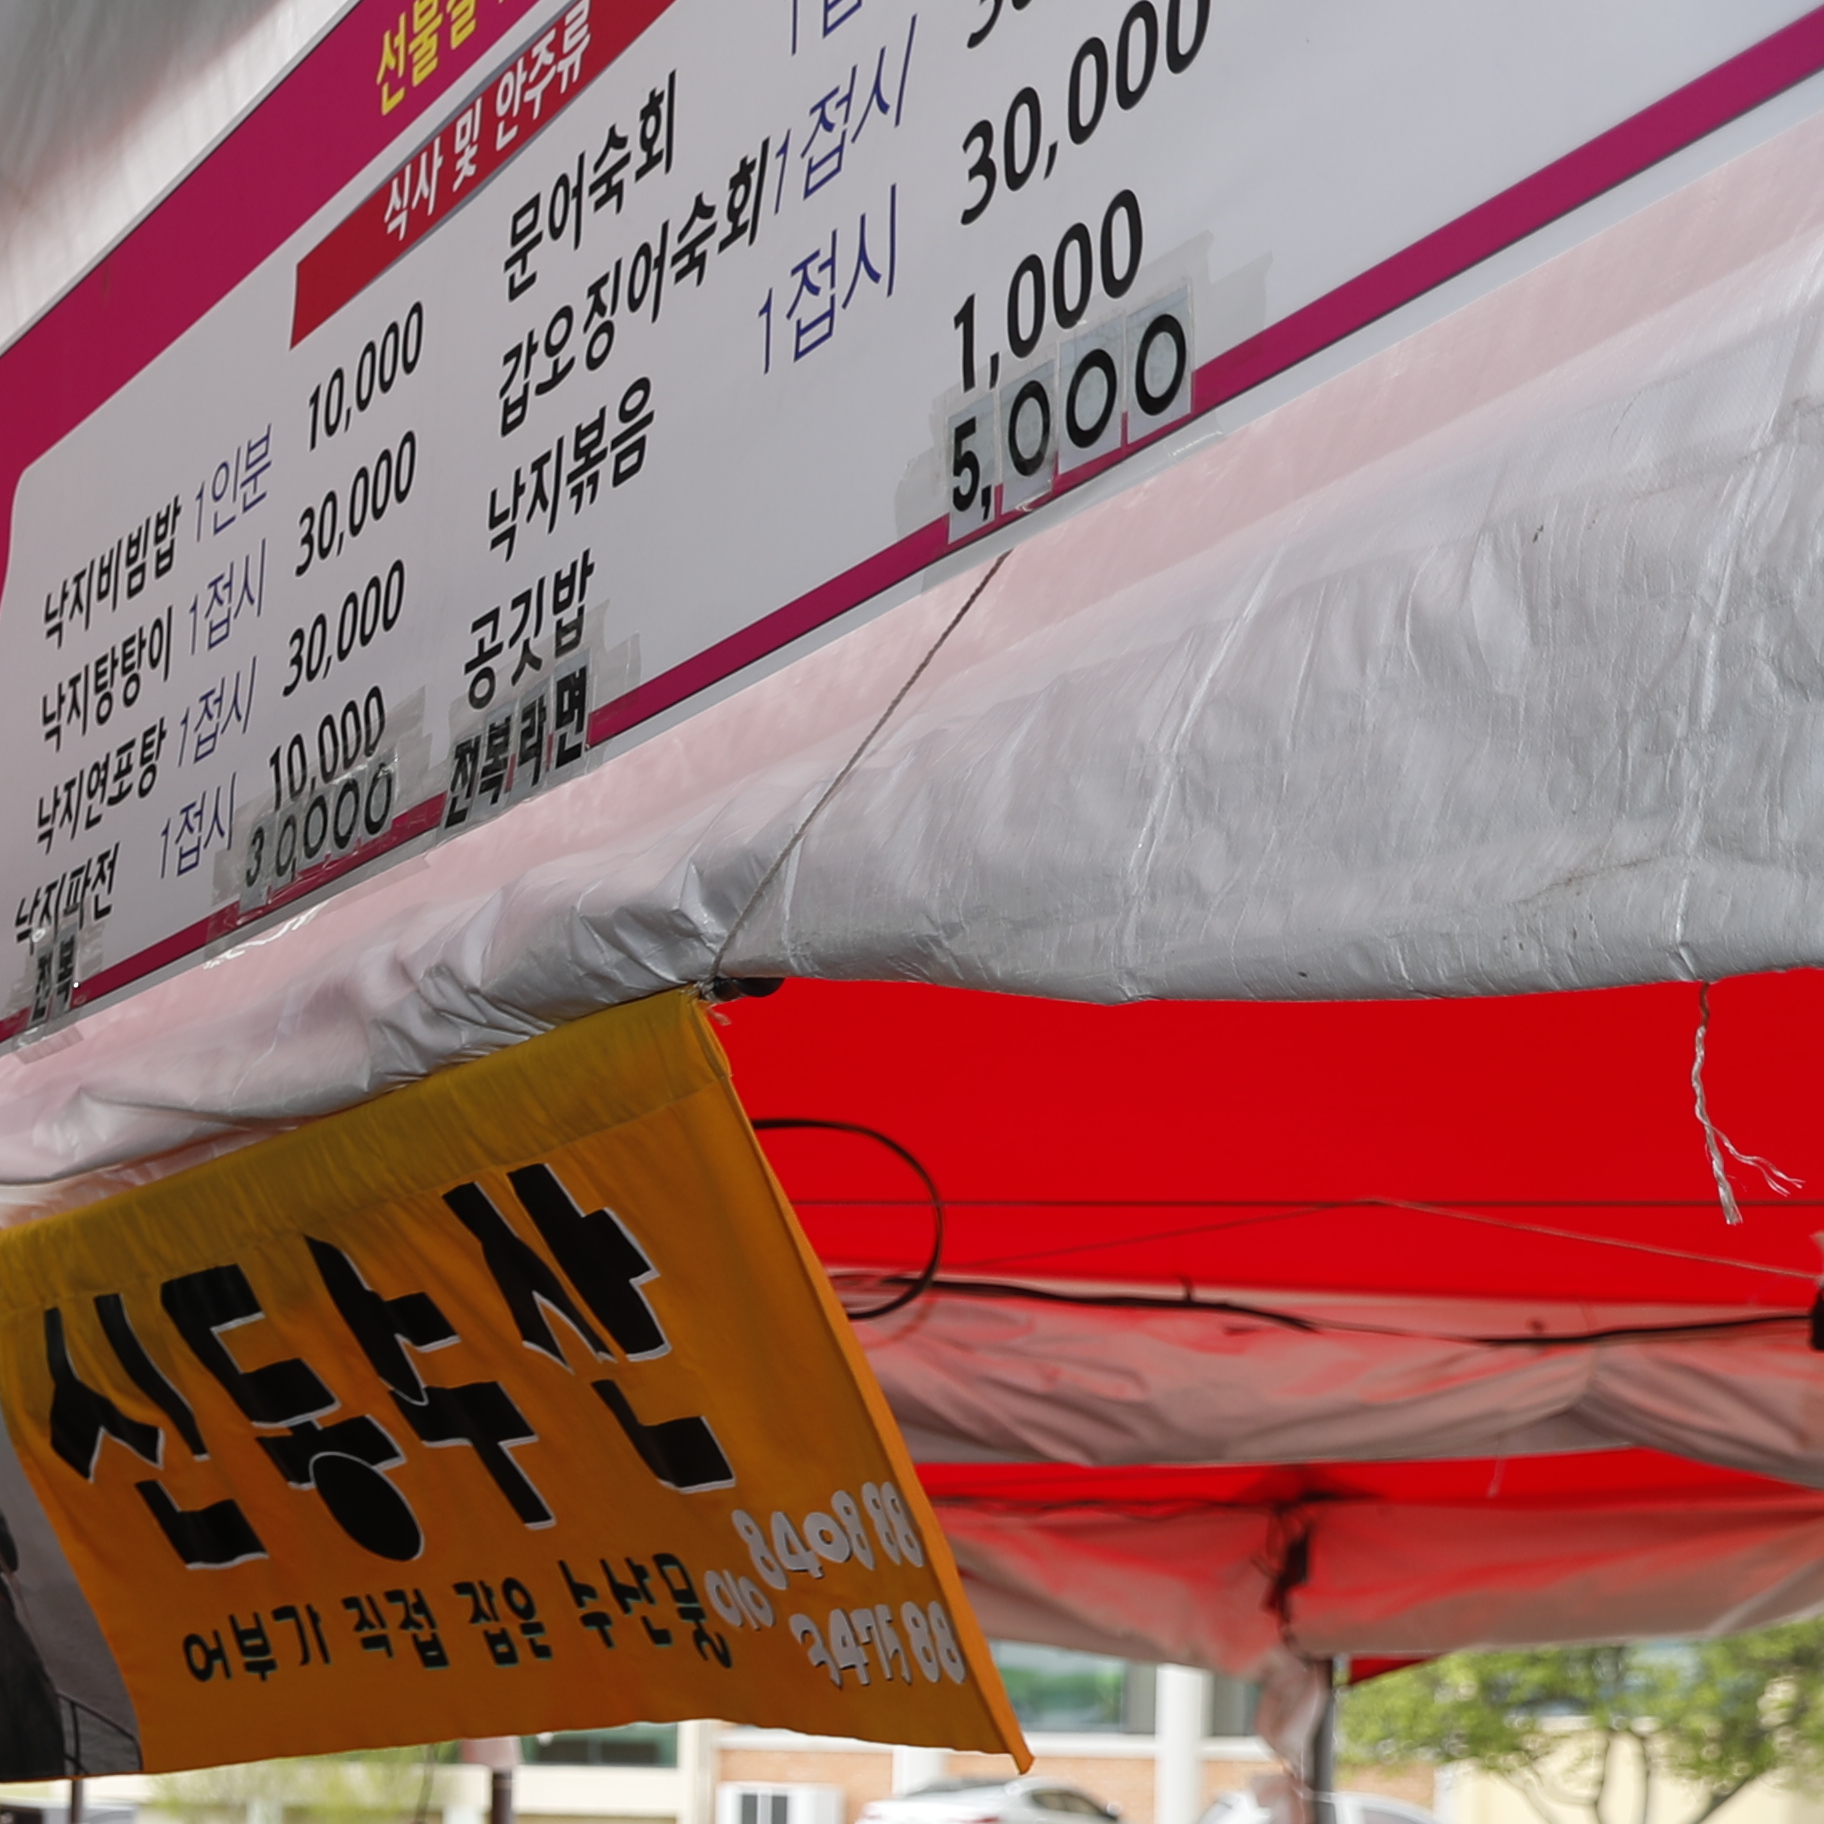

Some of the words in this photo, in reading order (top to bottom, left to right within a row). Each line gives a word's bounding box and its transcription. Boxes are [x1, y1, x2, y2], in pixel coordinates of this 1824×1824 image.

[384, 136, 443, 241] 식사
[452, 96, 482, 192] 및
[495, 0, 591, 151] 안주류
[499, 136, 770, 438] 갑오징어숙회
[774, 14, 918, 215] 1접시
[504, 69, 677, 302] 문어숙회
[488, 375, 655, 563] 낙지볶음
[758, 183, 897, 375] 1접시
[960, 0, 1212, 225] 30,000
[43, 494, 182, 650] 낙지비빔밥
[195, 423, 273, 543] 1인분
[307, 301, 424, 451] 10,000
[444, 664, 589, 830] 전복라면
[952, 314, 1187, 522] 5,000
[464, 547, 596, 710] 공깃밥
[954, 189, 1144, 393] 1,000
[36, 716, 168, 855] 낙지연포탕
[177, 655, 257, 769] 1접시
[283, 559, 405, 697] 30,000
[42, 604, 174, 753] 낙지탕탕이
[189, 537, 267, 656] 1접시
[295, 430, 416, 577] 30,000
[14, 841, 120, 956] 낙지파전
[160, 771, 237, 880] 1접시
[269, 685, 386, 812] 10,000
[30, 935, 76, 1023] 전복
[43, 1162, 736, 1570] 신동수산
[182, 1603, 332, 1682] 어부가
[341, 1588, 450, 1670] 직접
[451, 1577, 554, 1667] 잡은
[557, 1553, 733, 1670] 수산물
[704, 1569, 776, 1632] 010
[731, 1489, 876, 1591] 8408
[788, 1604, 913, 1690] 3475
